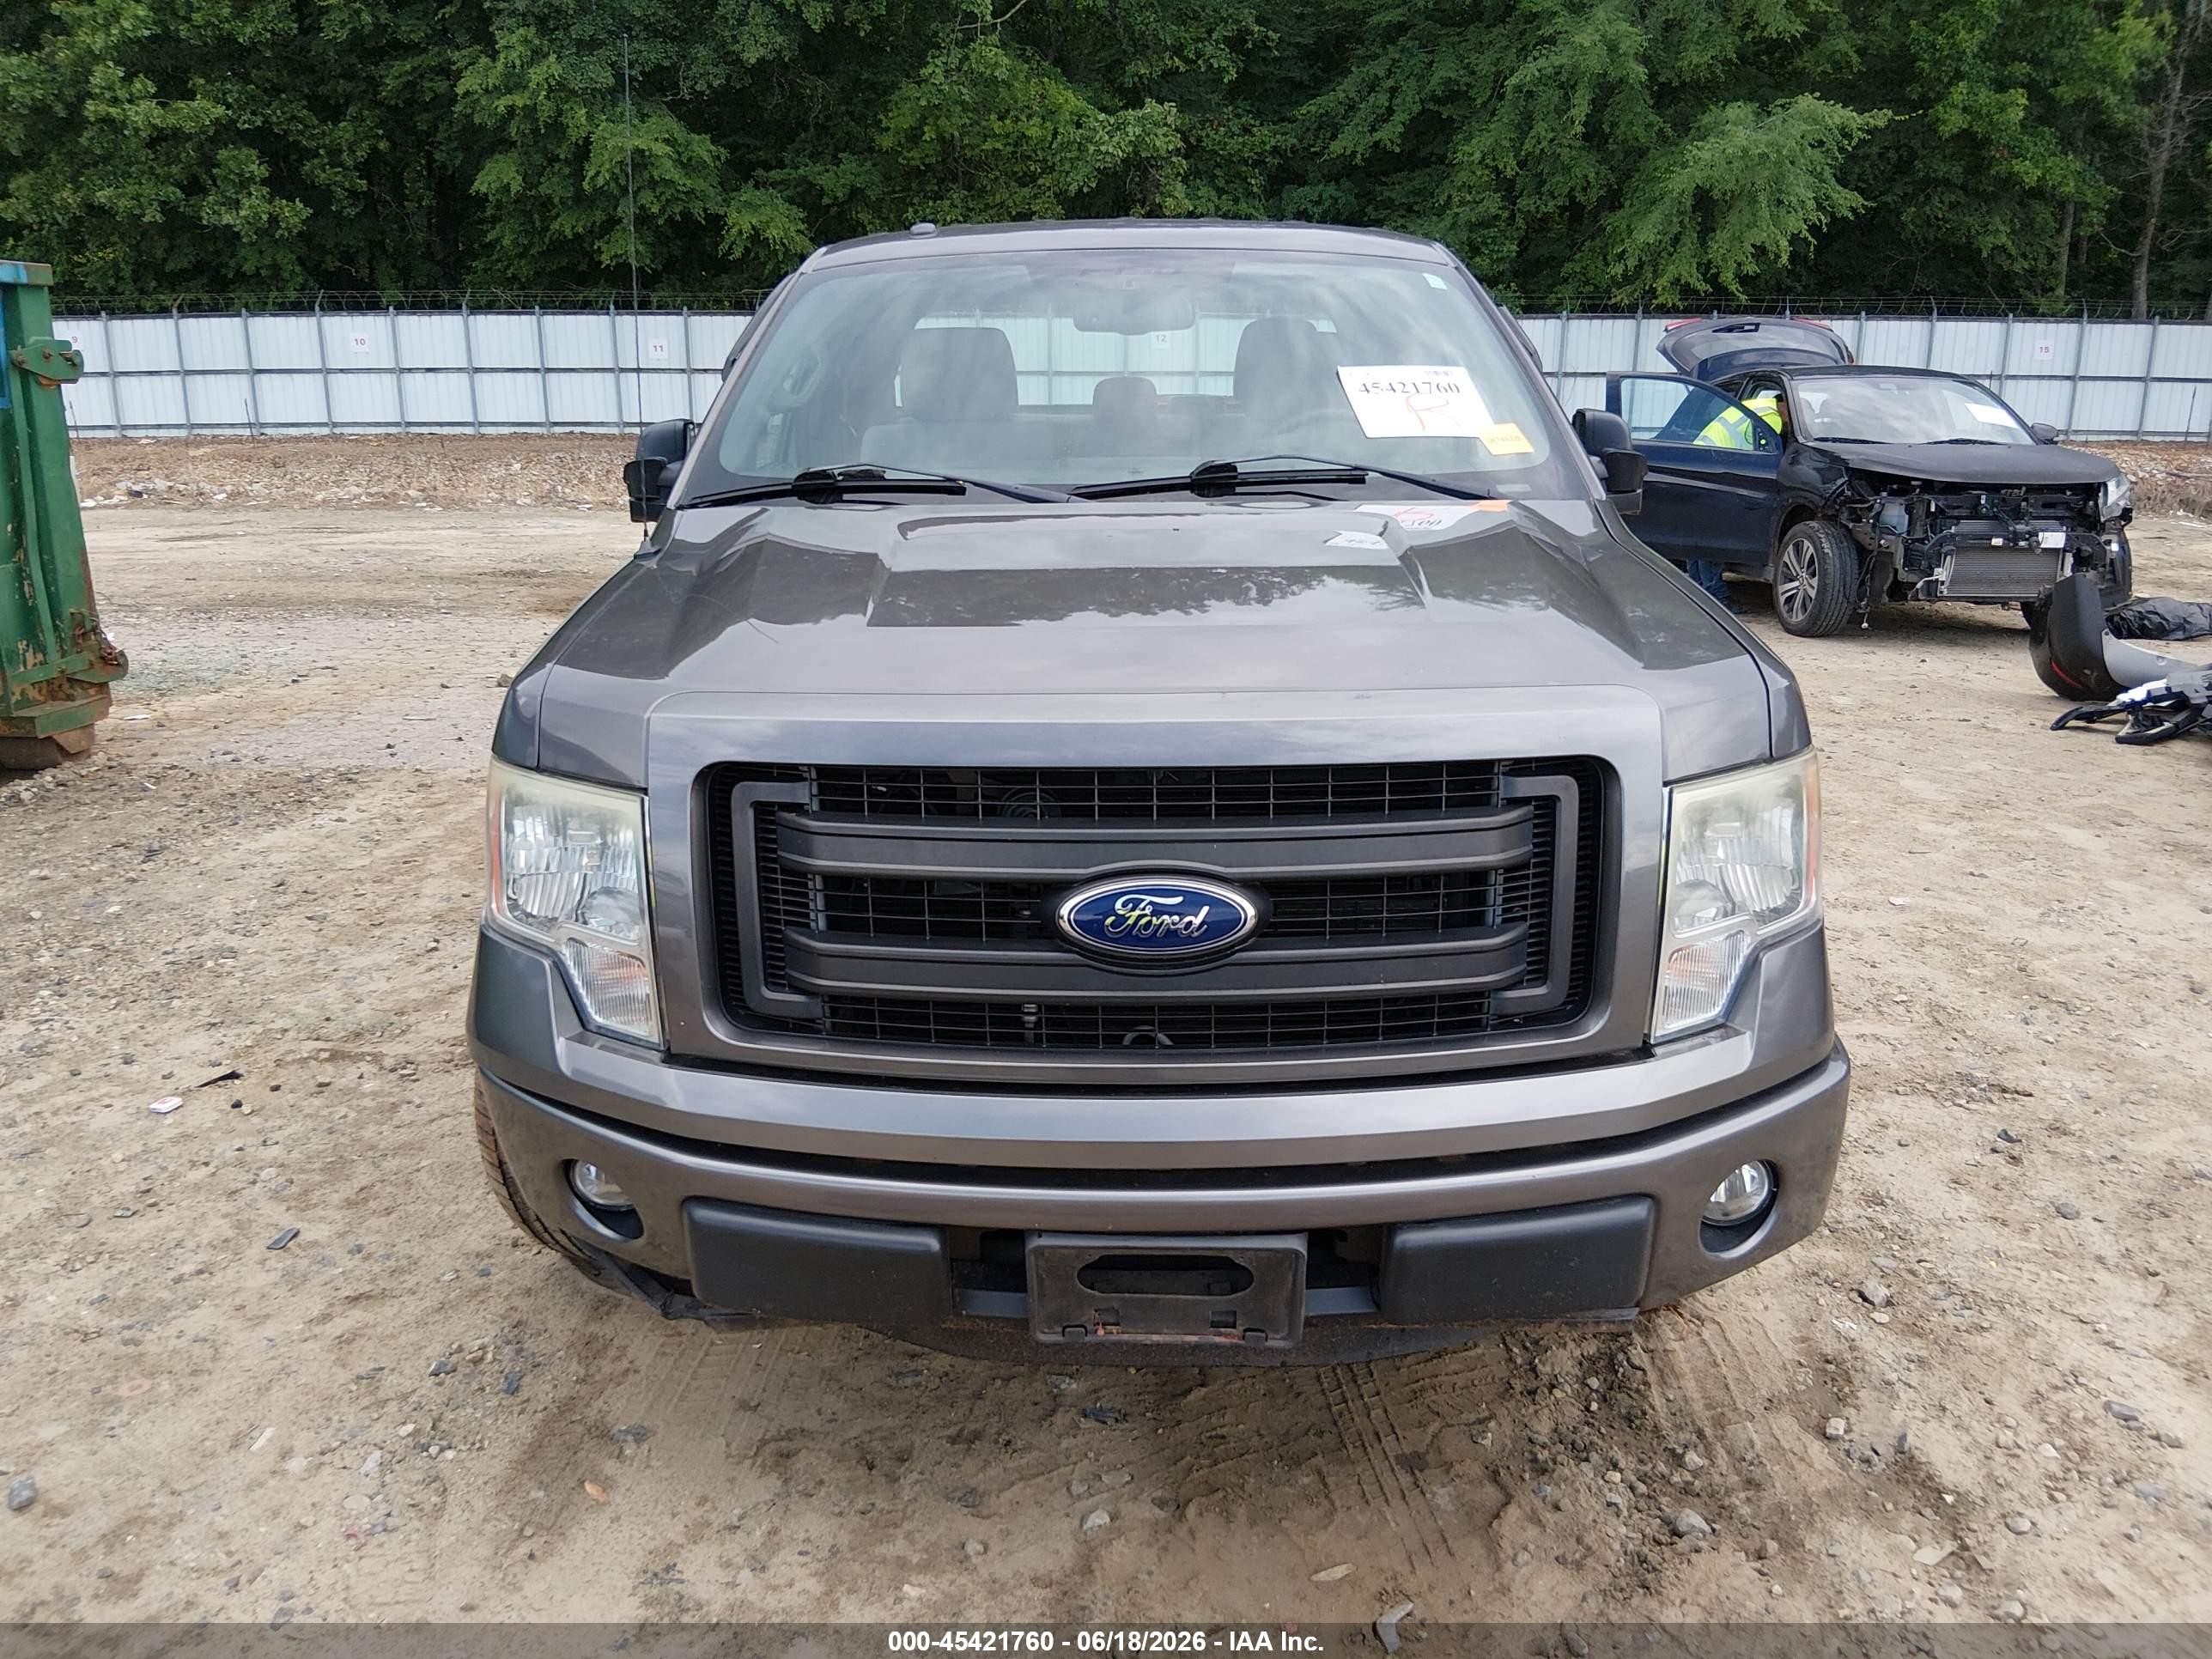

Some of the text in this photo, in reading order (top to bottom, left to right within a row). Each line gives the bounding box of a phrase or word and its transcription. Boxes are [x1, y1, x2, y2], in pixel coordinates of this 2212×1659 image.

[354, 337, 366, 346] 10
[1155, 334, 1168, 343] 12
[1105, 894, 1210, 938] Ford
